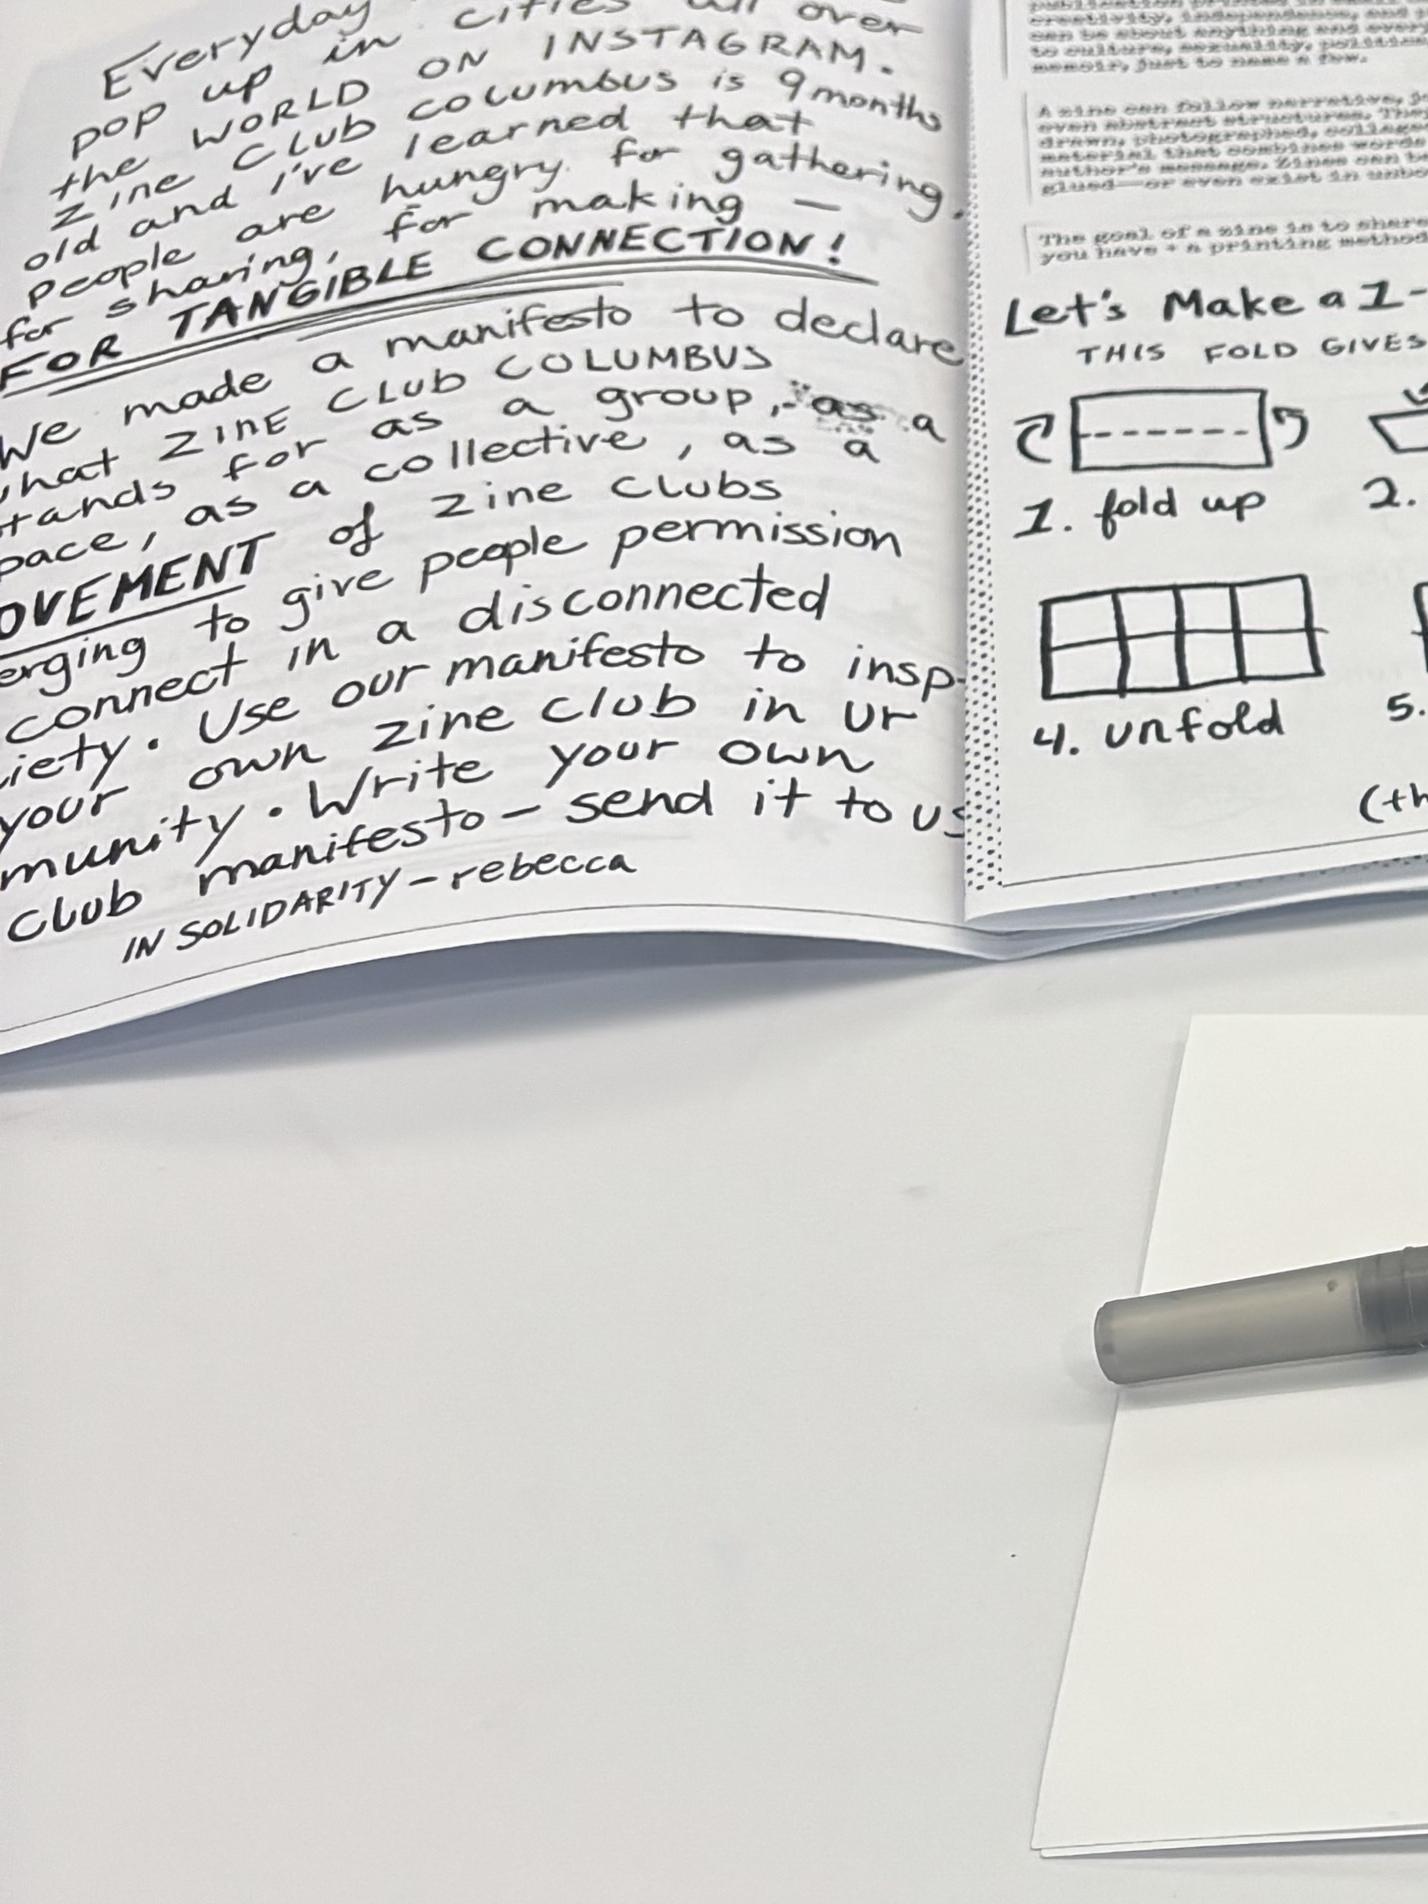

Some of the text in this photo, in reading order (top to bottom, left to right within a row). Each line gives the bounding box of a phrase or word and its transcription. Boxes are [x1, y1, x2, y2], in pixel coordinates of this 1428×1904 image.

[48, 153, 150, 203] the
[417, 49, 488, 79] ON
[543, 25, 893, 75] INSTAGRAM.
[72, 102, 167, 161] pop
[202, 64, 273, 105] up
[322, 34, 401, 65] in
[796, 1, 923, 36] over
[0, 228, 850, 395] FOR TANGIBLE CONNECTION!
[124, 369, 272, 426] made
[312, 352, 354, 374] a
[383, 296, 634, 359] manifesto
[672, 293, 744, 327] to
[772, 293, 967, 371] declare
[1004, 288, 1127, 337] Let's
[1163, 285, 1305, 322] Make
[1318, 290, 1346, 309] a
[1076, 343, 1165, 365] THIS
[1204, 342, 1298, 364] FOLD
[1321, 333, 1427, 356] GIVES
[1013, 485, 1266, 540] 1. fold up
[1362, 476, 1416, 510] 2.
[0, 529, 278, 641] OVEMENT
[328, 501, 384, 557] of
[431, 481, 572, 518] zine
[5, 562, 830, 746] connect in a disconnected
[1387, 692, 1426, 722] 5.
[1033, 698, 1285, 756] 4. unfold
[7, 879, 142, 942] club
[197, 796, 488, 899] manifesto
[565, 779, 713, 824] send
[754, 777, 812, 818] it
[835, 786, 892, 823] to
[122, 928, 165, 964] IN
[176, 867, 402, 951] SOLIDARITY
